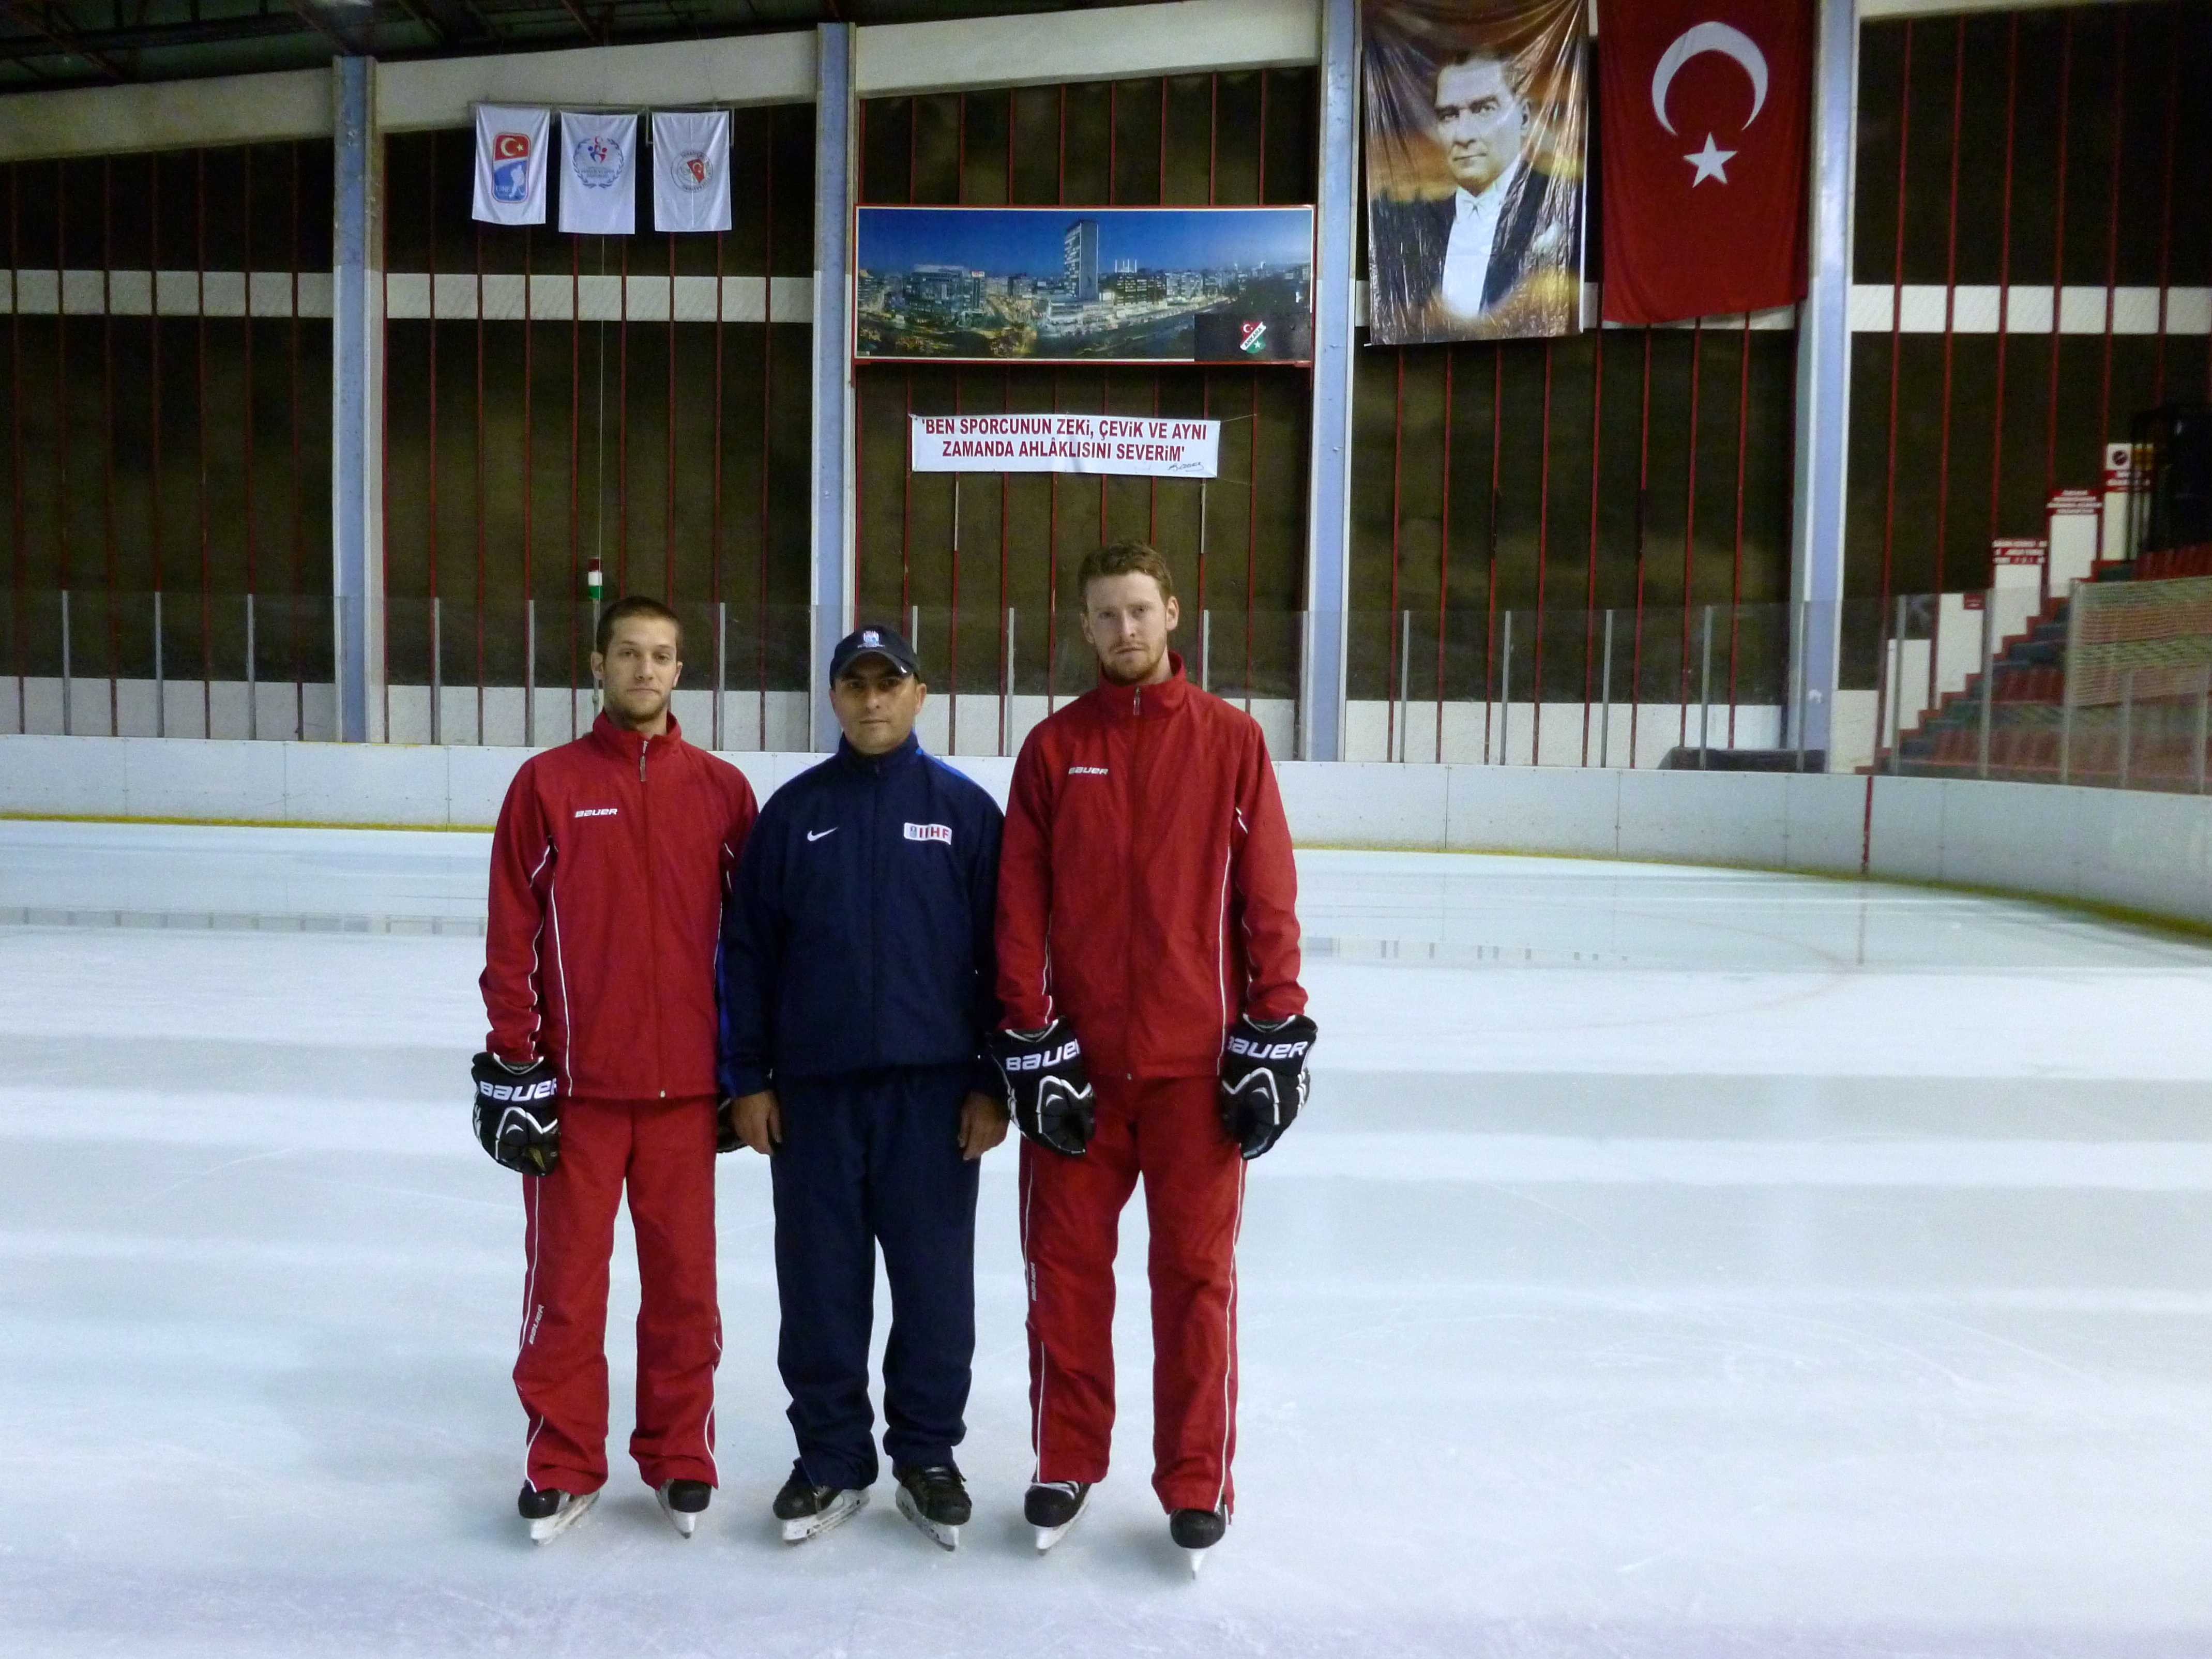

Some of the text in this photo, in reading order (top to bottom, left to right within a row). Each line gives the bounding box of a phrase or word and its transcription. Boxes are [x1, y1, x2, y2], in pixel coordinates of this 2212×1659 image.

[1245, 327, 1262, 347] ANKARA
[960, 418, 1052, 434] SPORCUNUN
[1148, 422, 1168, 438] VE
[1172, 423, 1206, 440] AYNI
[943, 441, 1014, 457] ZAMANDA
[1019, 437, 1111, 459] AHLÂKLISINI
[575, 808, 618, 818] BAUER
[919, 826, 949, 839] IIHF
